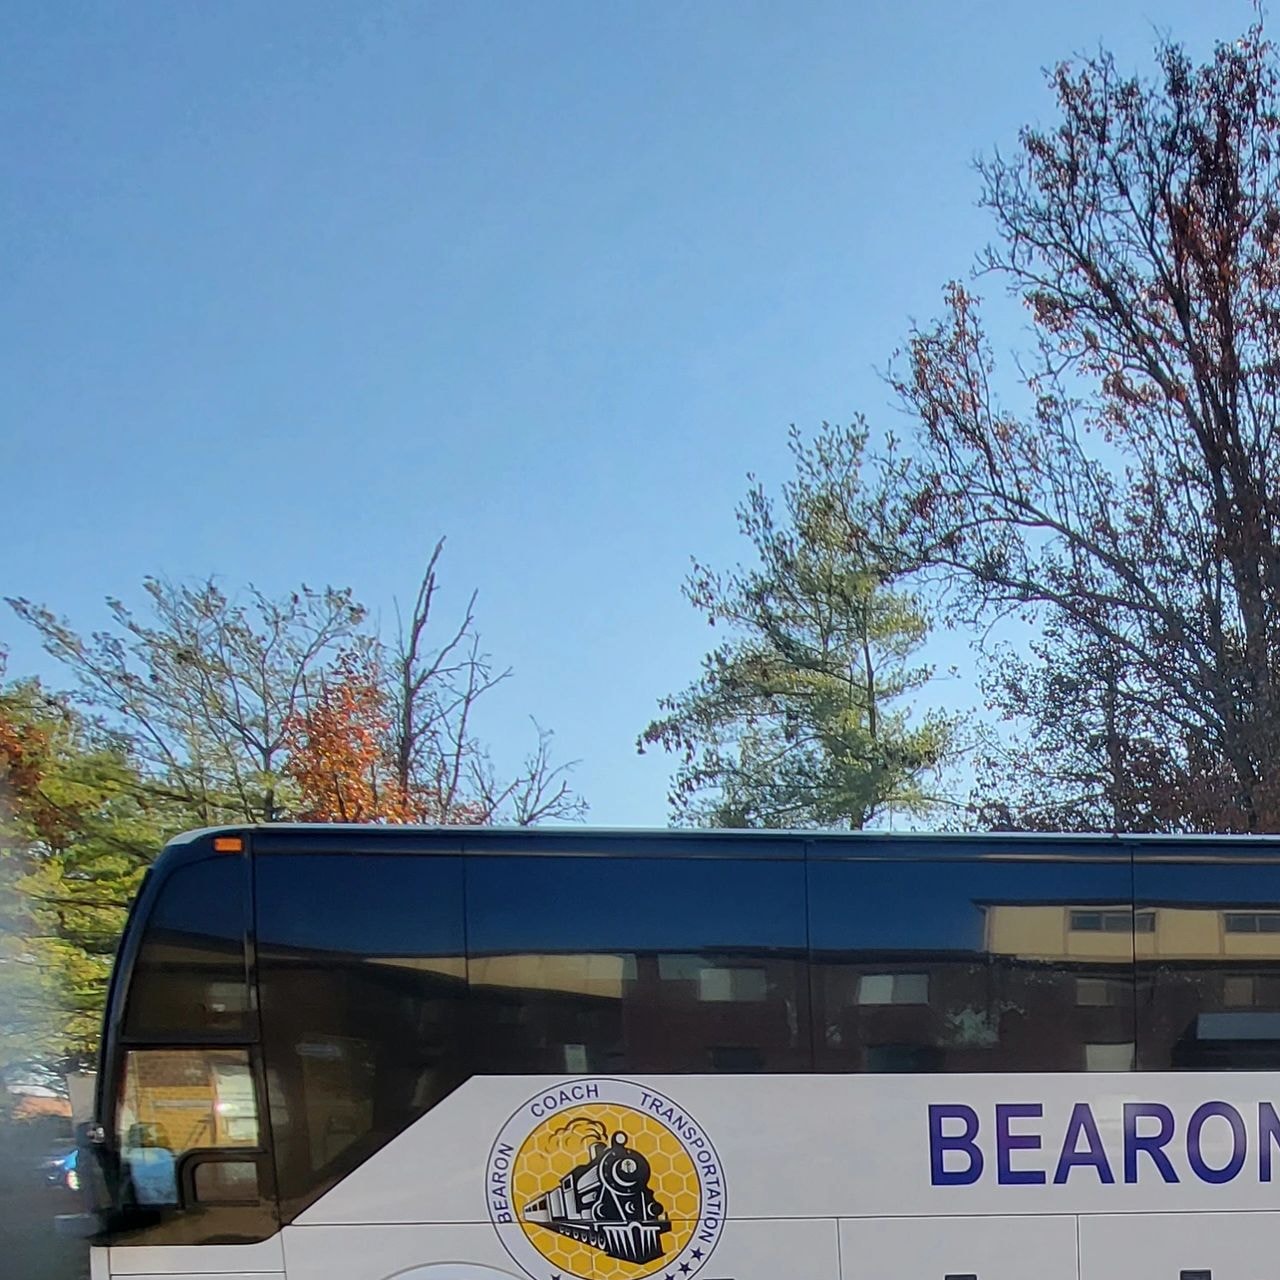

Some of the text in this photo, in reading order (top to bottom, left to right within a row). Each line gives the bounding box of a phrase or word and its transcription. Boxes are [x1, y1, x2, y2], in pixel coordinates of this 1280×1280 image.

[492, 1084, 721, 1243] BEARON COACH TRANSPORTATION
